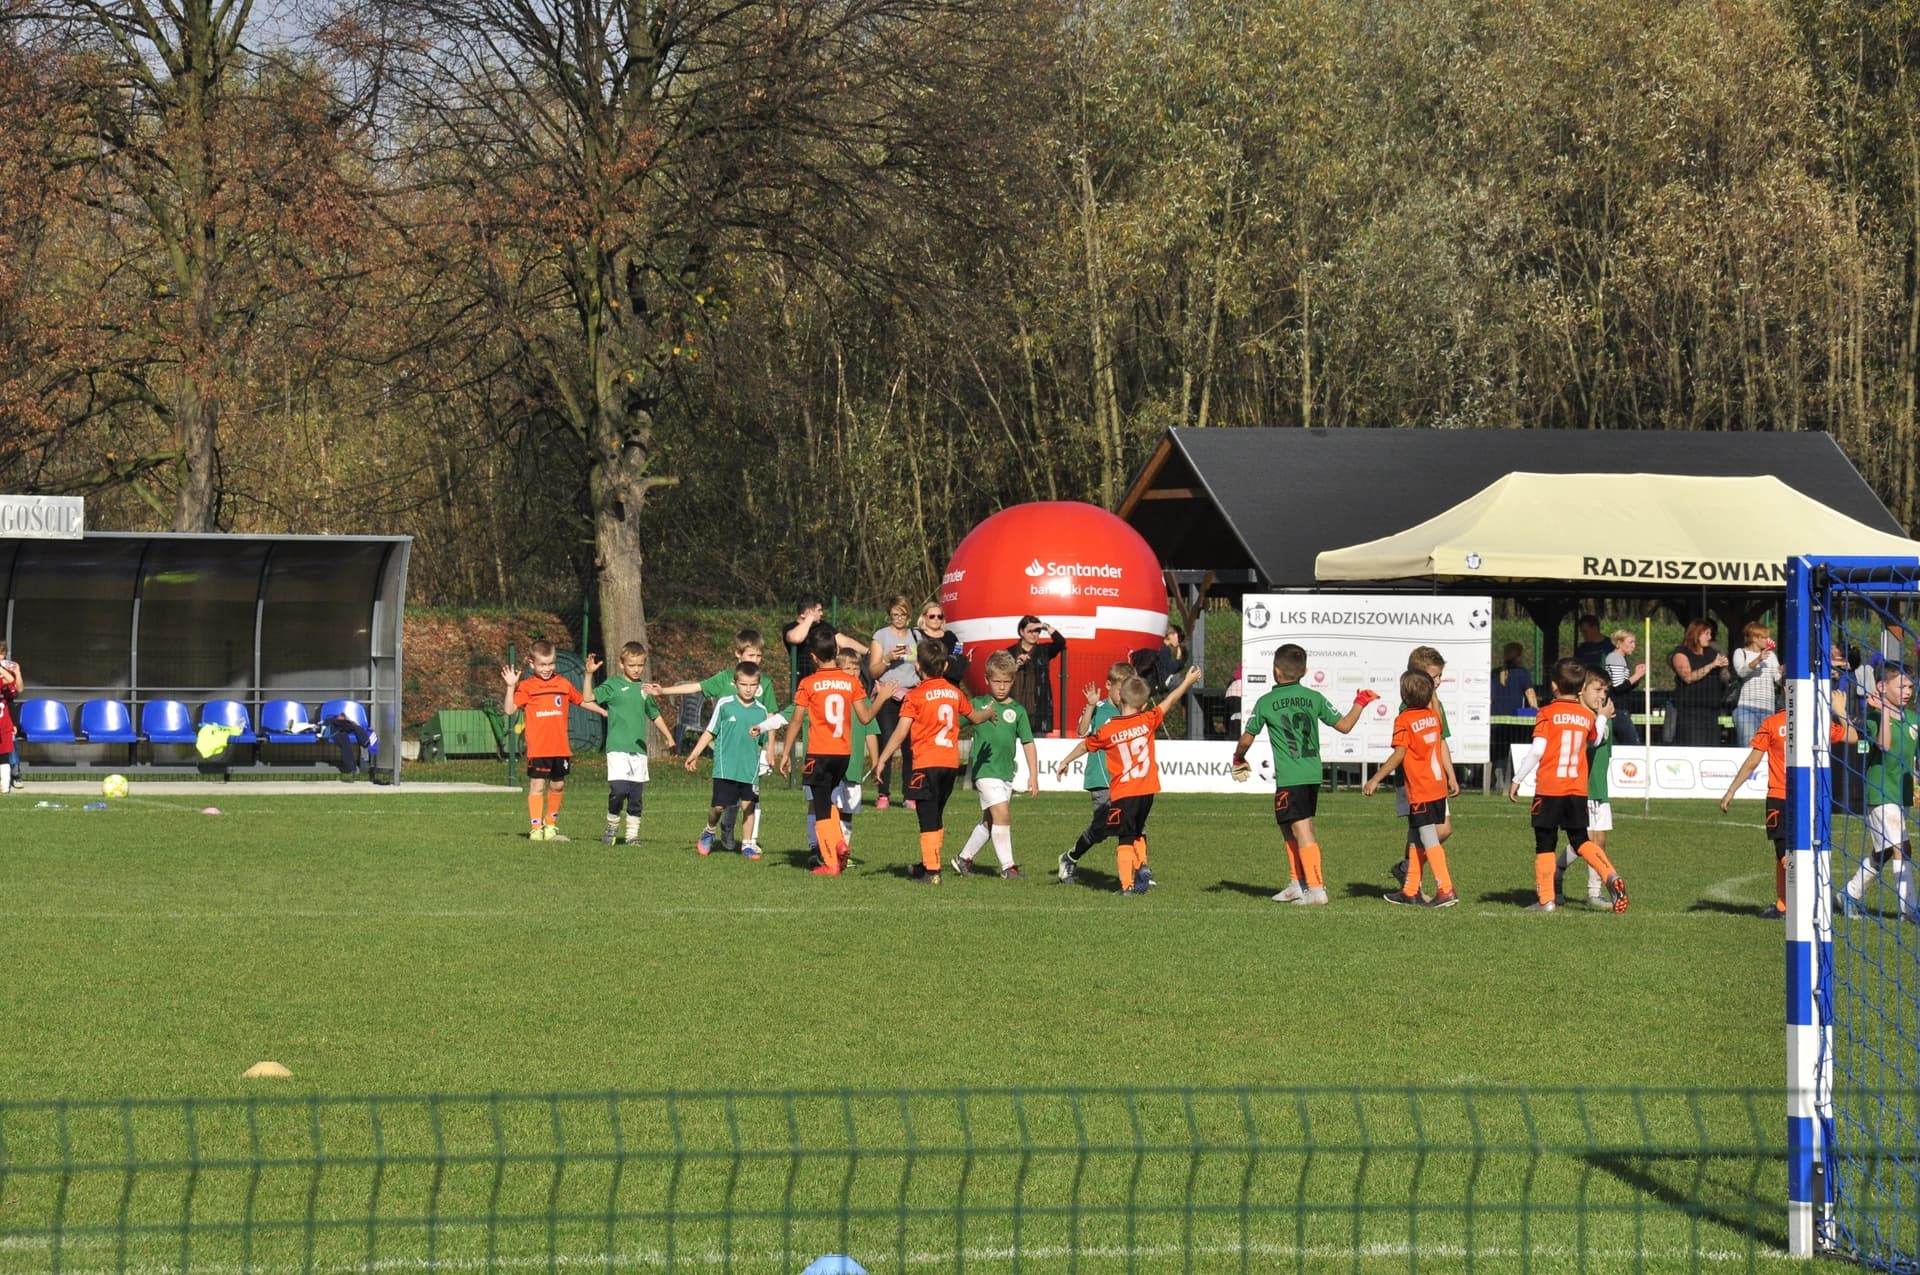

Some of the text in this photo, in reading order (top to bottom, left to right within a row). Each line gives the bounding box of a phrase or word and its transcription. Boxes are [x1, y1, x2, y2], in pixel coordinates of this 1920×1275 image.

[1, 498, 80, 532] GOŚCIE
[1047, 562, 1123, 578] Santander
[1084, 585, 1120, 597] chcesz
[1280, 611, 1454, 626] LKS RADZISZOWIANKA
[824, 693, 845, 738] 9
[934, 704, 954, 748] 2
[1272, 697, 1313, 712] CLEPARDIA
[1282, 712, 1317, 759] 12
[1423, 731, 1442, 781] 7
[1557, 729, 1583, 778] 11
[1117, 736, 1150, 782] 13
